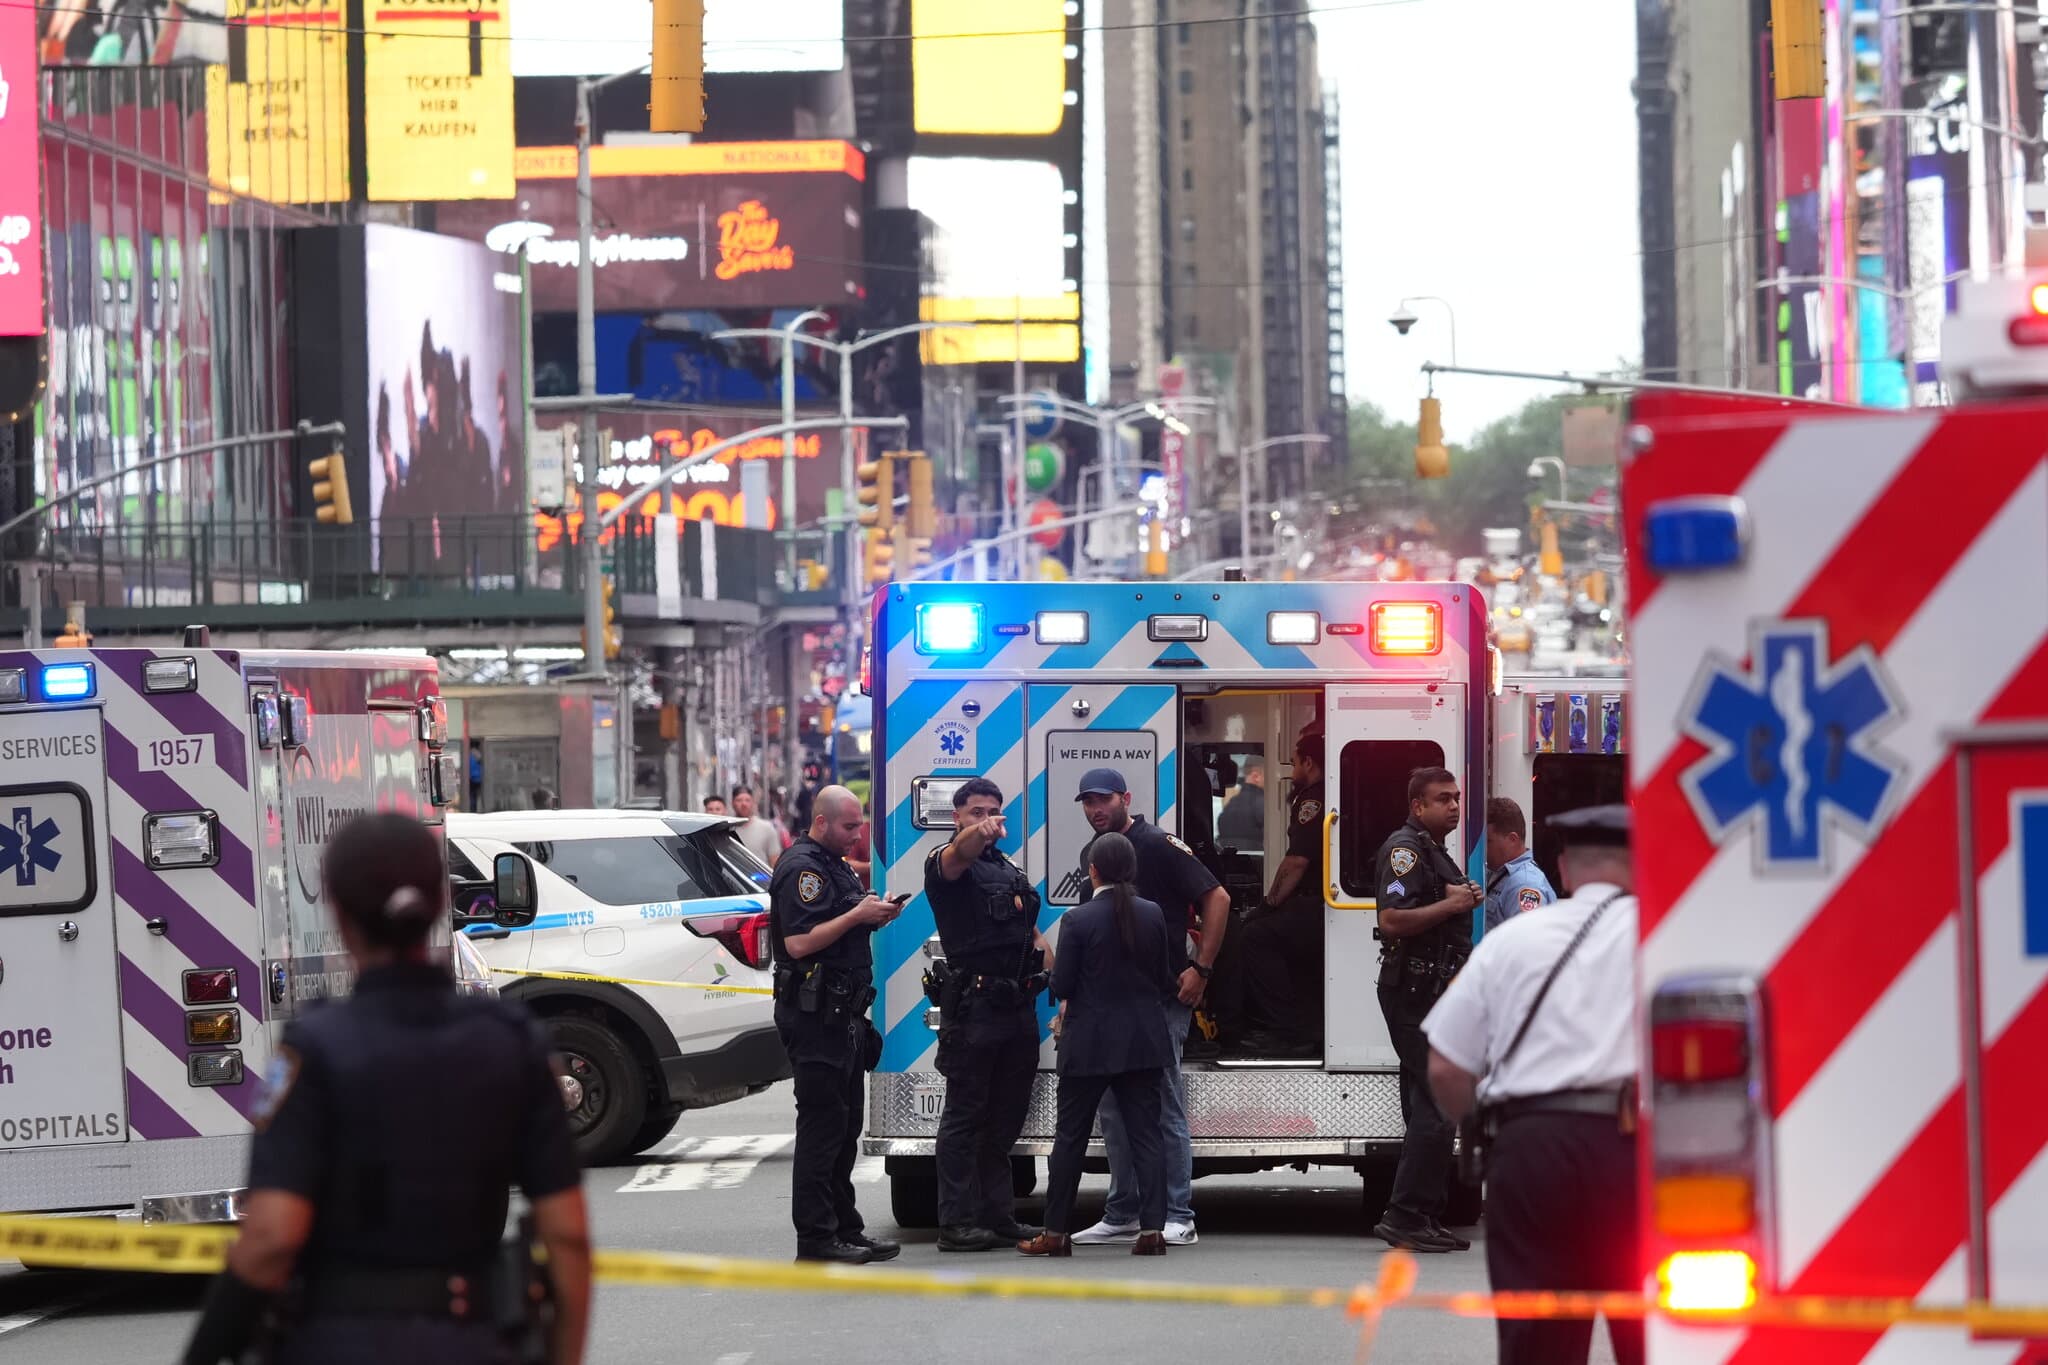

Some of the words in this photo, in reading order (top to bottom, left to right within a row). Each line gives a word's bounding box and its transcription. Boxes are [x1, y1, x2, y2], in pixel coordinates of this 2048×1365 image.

[407, 76, 473, 90] TICKETS
[421, 99, 457, 112] HIER
[405, 123, 476, 137] KAUFEN
[2, 735, 97, 760] SERVICES
[149, 738, 203, 767] 1957
[1060, 749, 1079, 760] WE
[1081, 749, 1111, 760] FIND
[1113, 749, 1123, 760] A
[1125, 749, 1151, 760] WAY
[933, 757, 971, 765] CERTIFIED
[296, 796, 321, 845] NYU
[567, 910, 594, 926] MTS
[640, 903, 672, 918] 4520
[704, 990, 737, 1000] HYBRID
[0, 1027, 52, 1051] one
[921, 1094, 942, 1114] 107
[1, 1112, 120, 1142] OSPITALS
